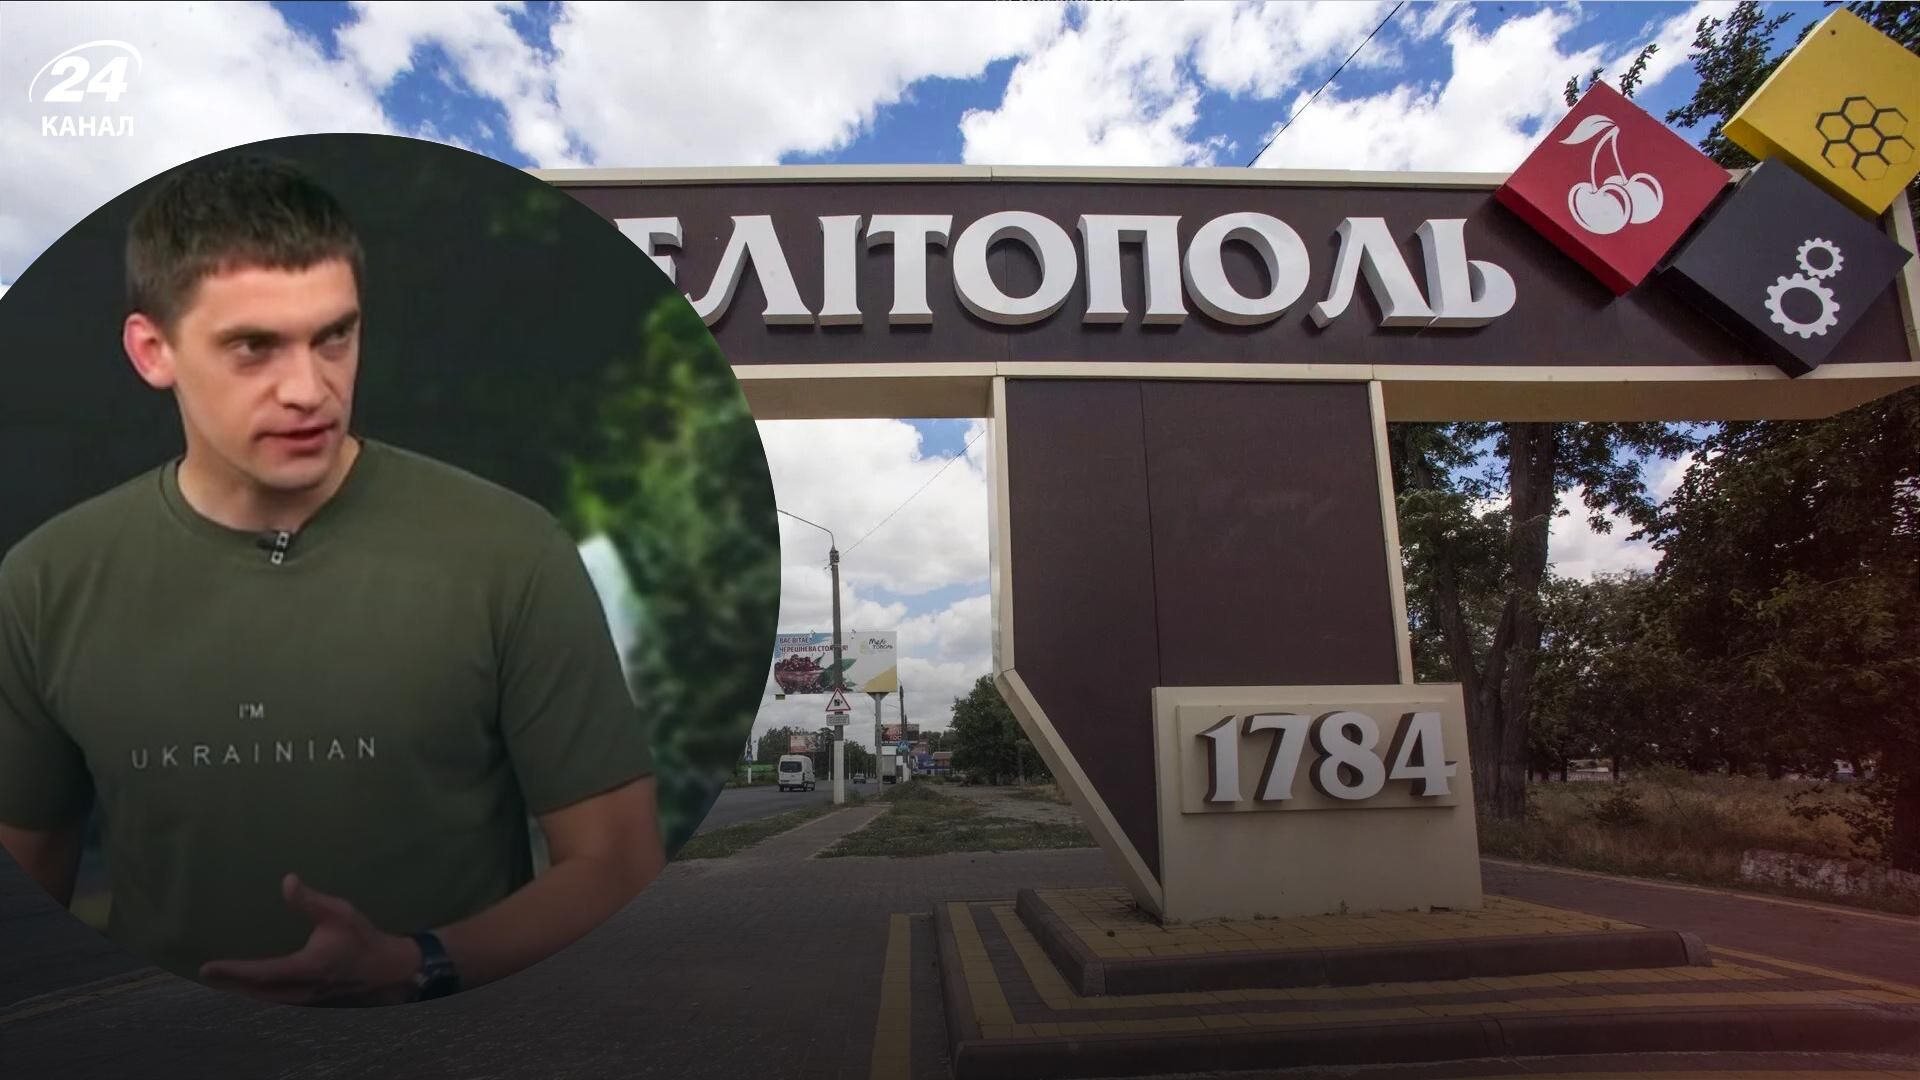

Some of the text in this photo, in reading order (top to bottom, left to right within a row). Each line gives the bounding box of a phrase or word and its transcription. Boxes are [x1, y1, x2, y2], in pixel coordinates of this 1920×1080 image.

[238, 703, 264, 719] I'M
[131, 736, 376, 769] UKRAINIAN
[1196, 711, 1457, 802] 1784
